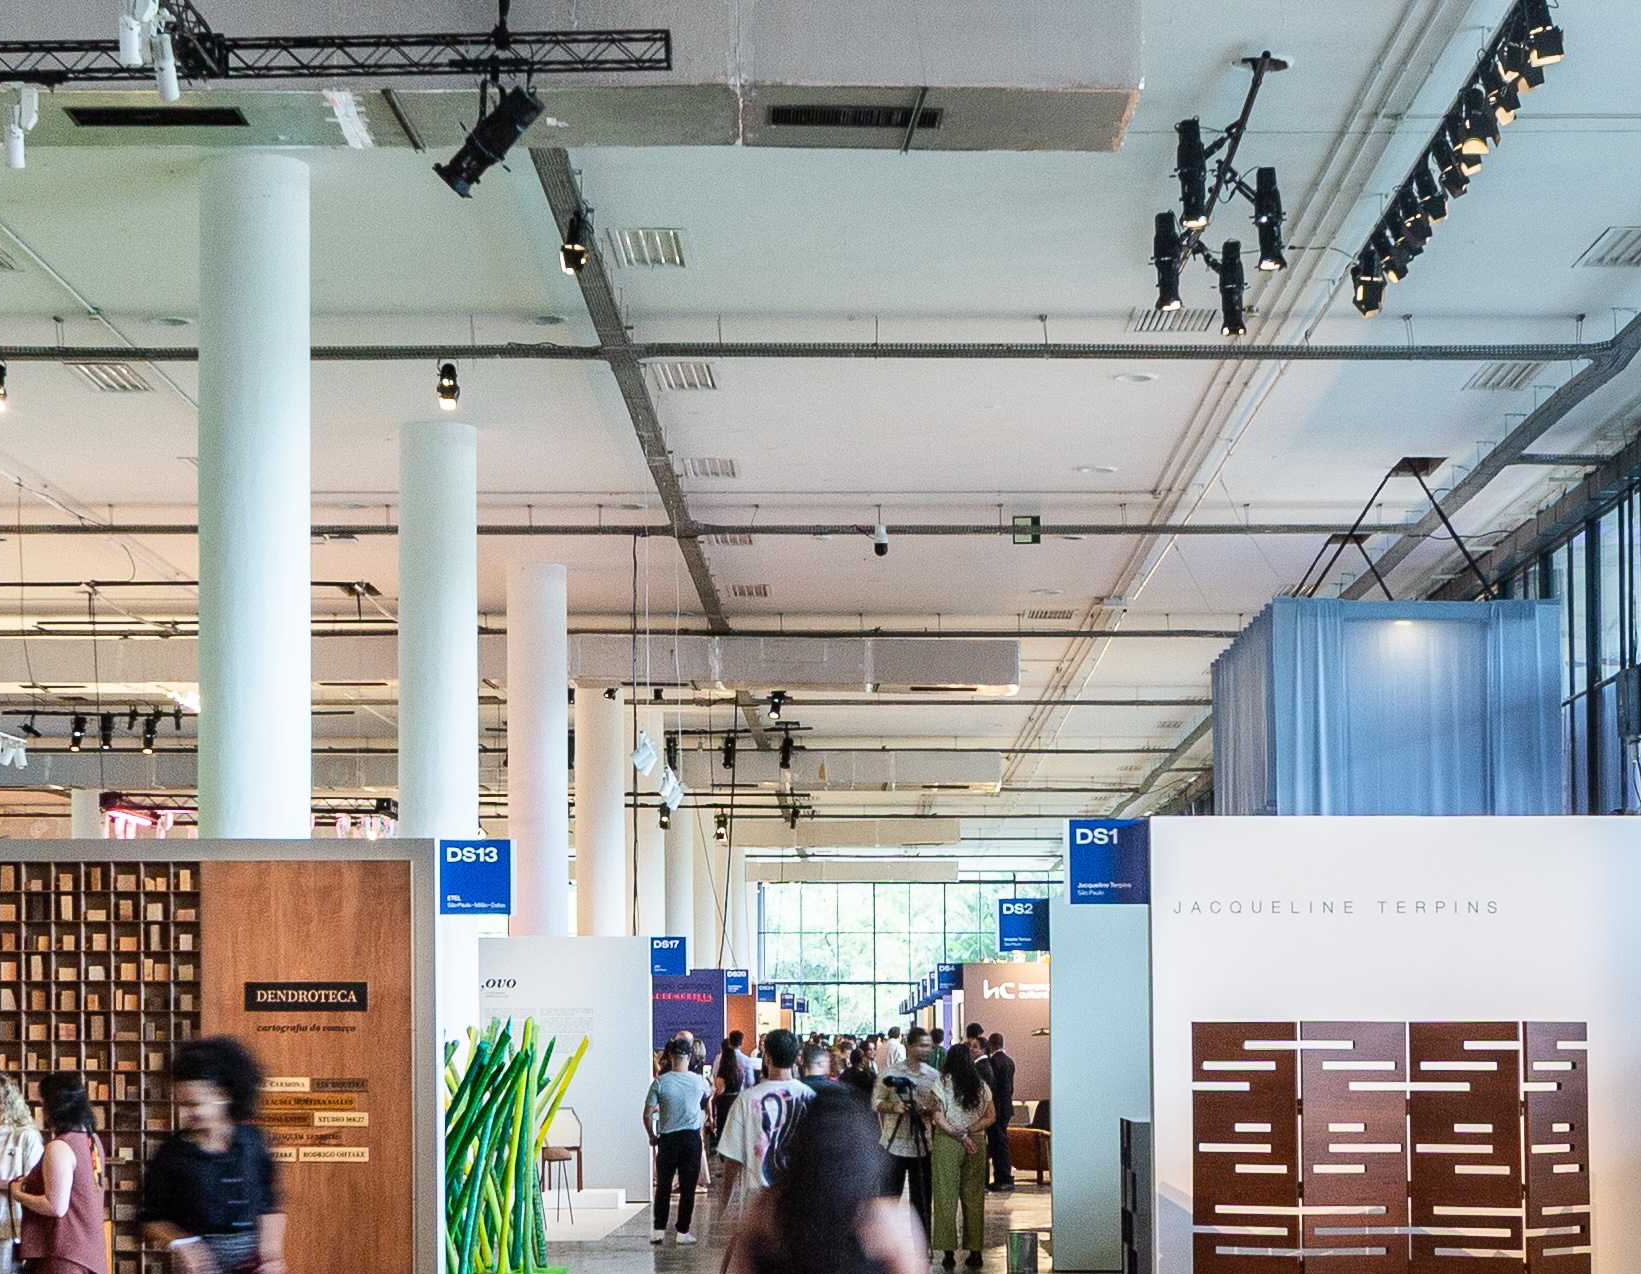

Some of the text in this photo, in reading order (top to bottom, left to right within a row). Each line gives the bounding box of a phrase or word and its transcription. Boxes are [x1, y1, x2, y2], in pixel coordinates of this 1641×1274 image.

[1075, 827, 1118, 845] DS1
[446, 846, 498, 863] DS13
[1002, 903, 1034, 915] DS2
[1173, 900, 1499, 915] JACQUELINE TERPINS
[653, 939, 680, 949] DS17
[255, 989, 358, 1003] DENDROTECA
[256, 1023, 308, 1034] cartografia
